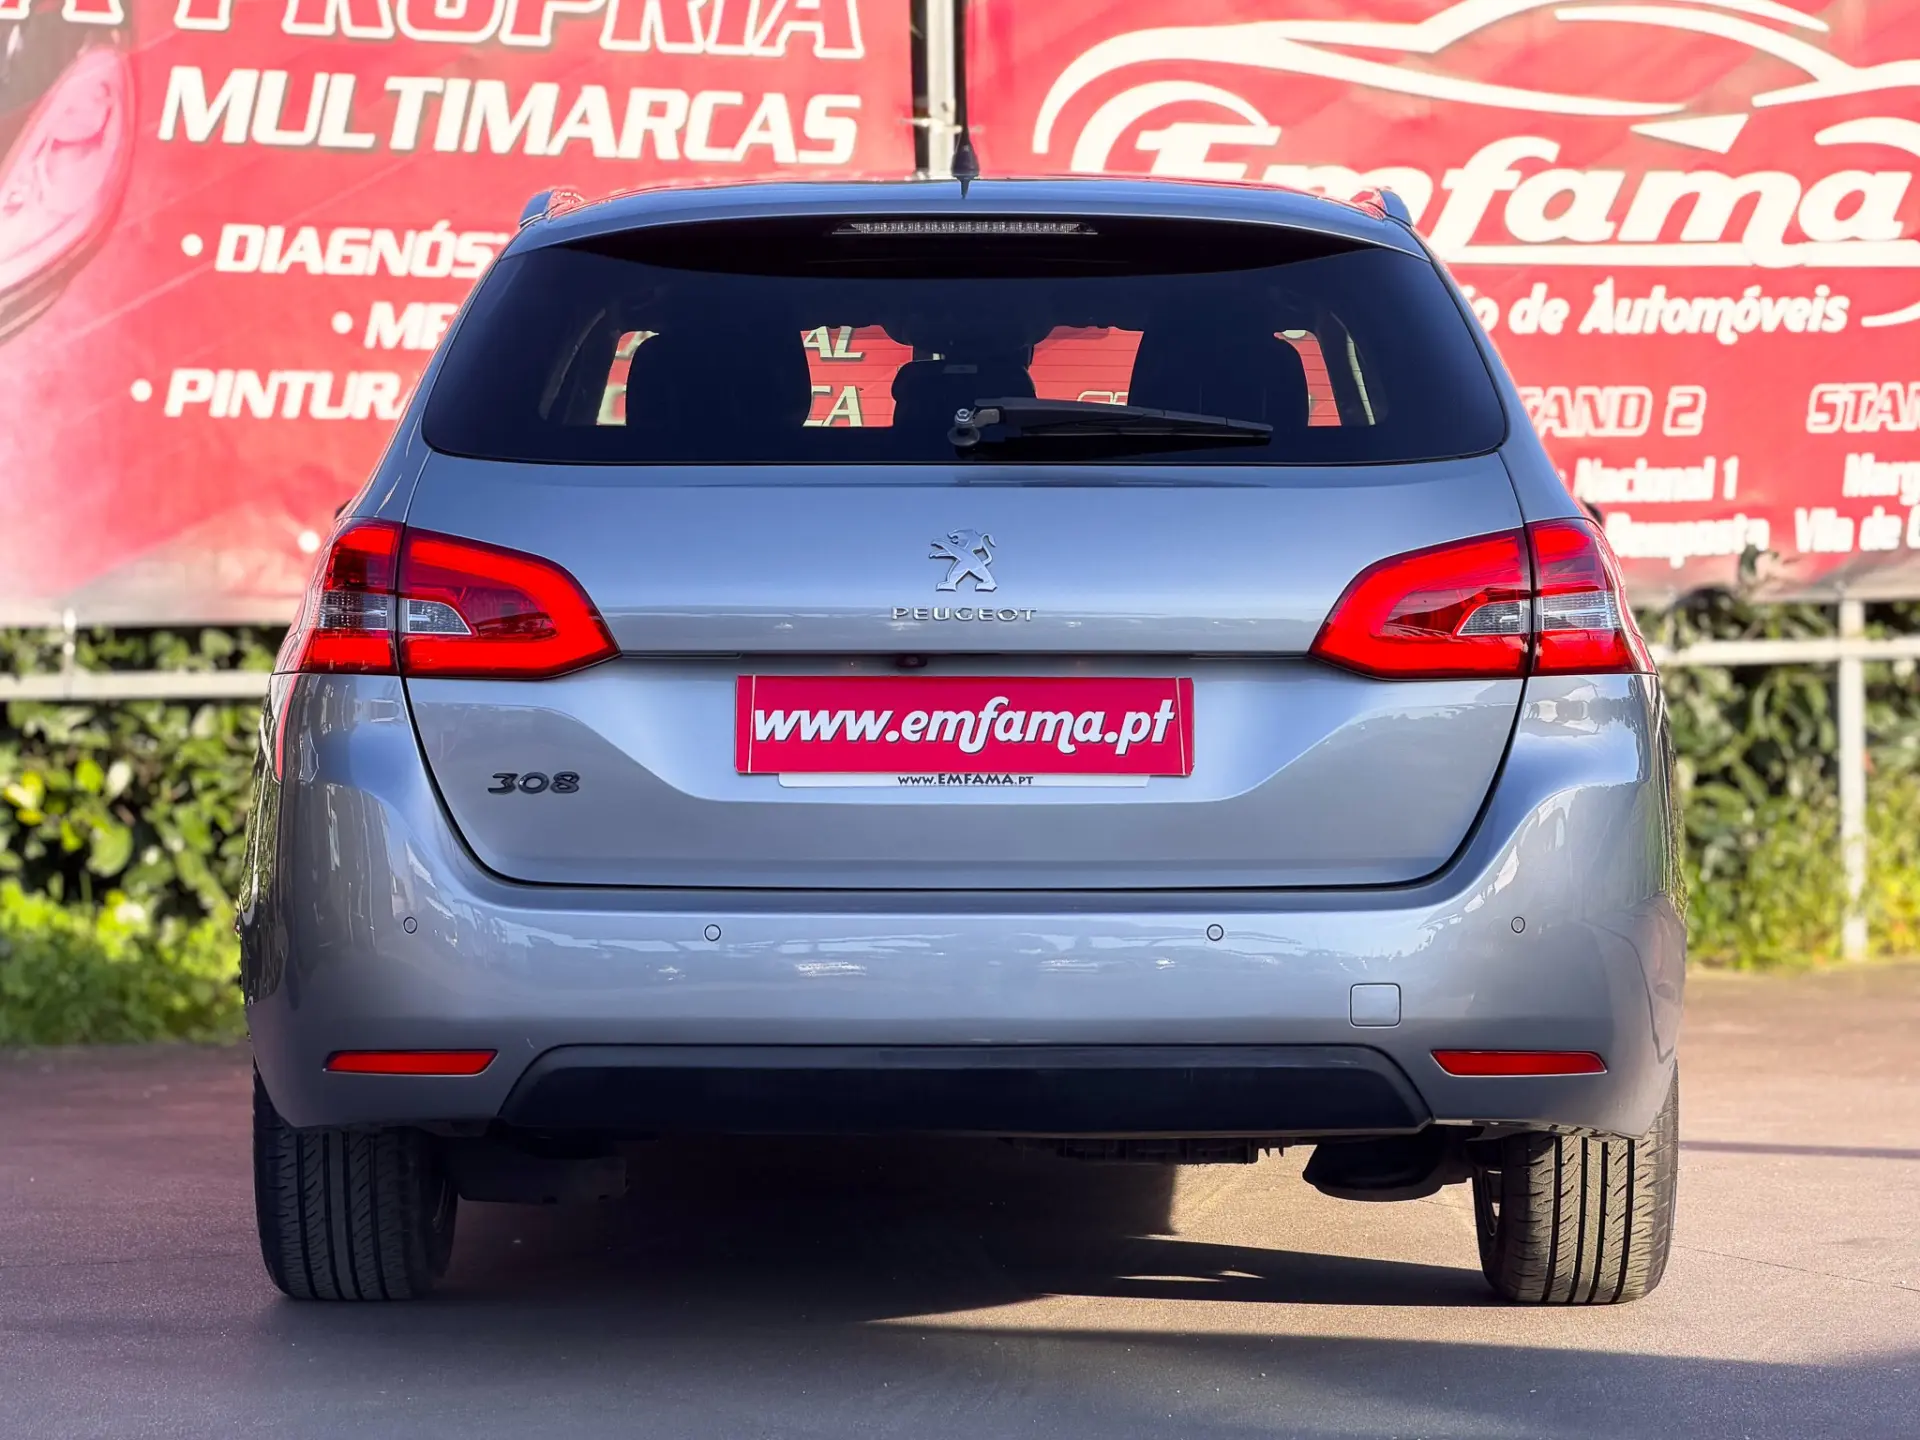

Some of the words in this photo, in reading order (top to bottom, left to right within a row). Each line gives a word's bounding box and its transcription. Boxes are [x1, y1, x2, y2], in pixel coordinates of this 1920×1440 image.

[158, 66, 861, 165] MULTIMARCAS
[215, 219, 510, 279] DIAGNÓS
[1508, 282, 1570, 335] de
[1578, 276, 1851, 345] Automóveis
[1663, 385, 1707, 436] 2
[891, 606, 1038, 621] PEUGEOT
[754, 696, 1176, 755] www.emfama.pt
[487, 771, 580, 794] 308
